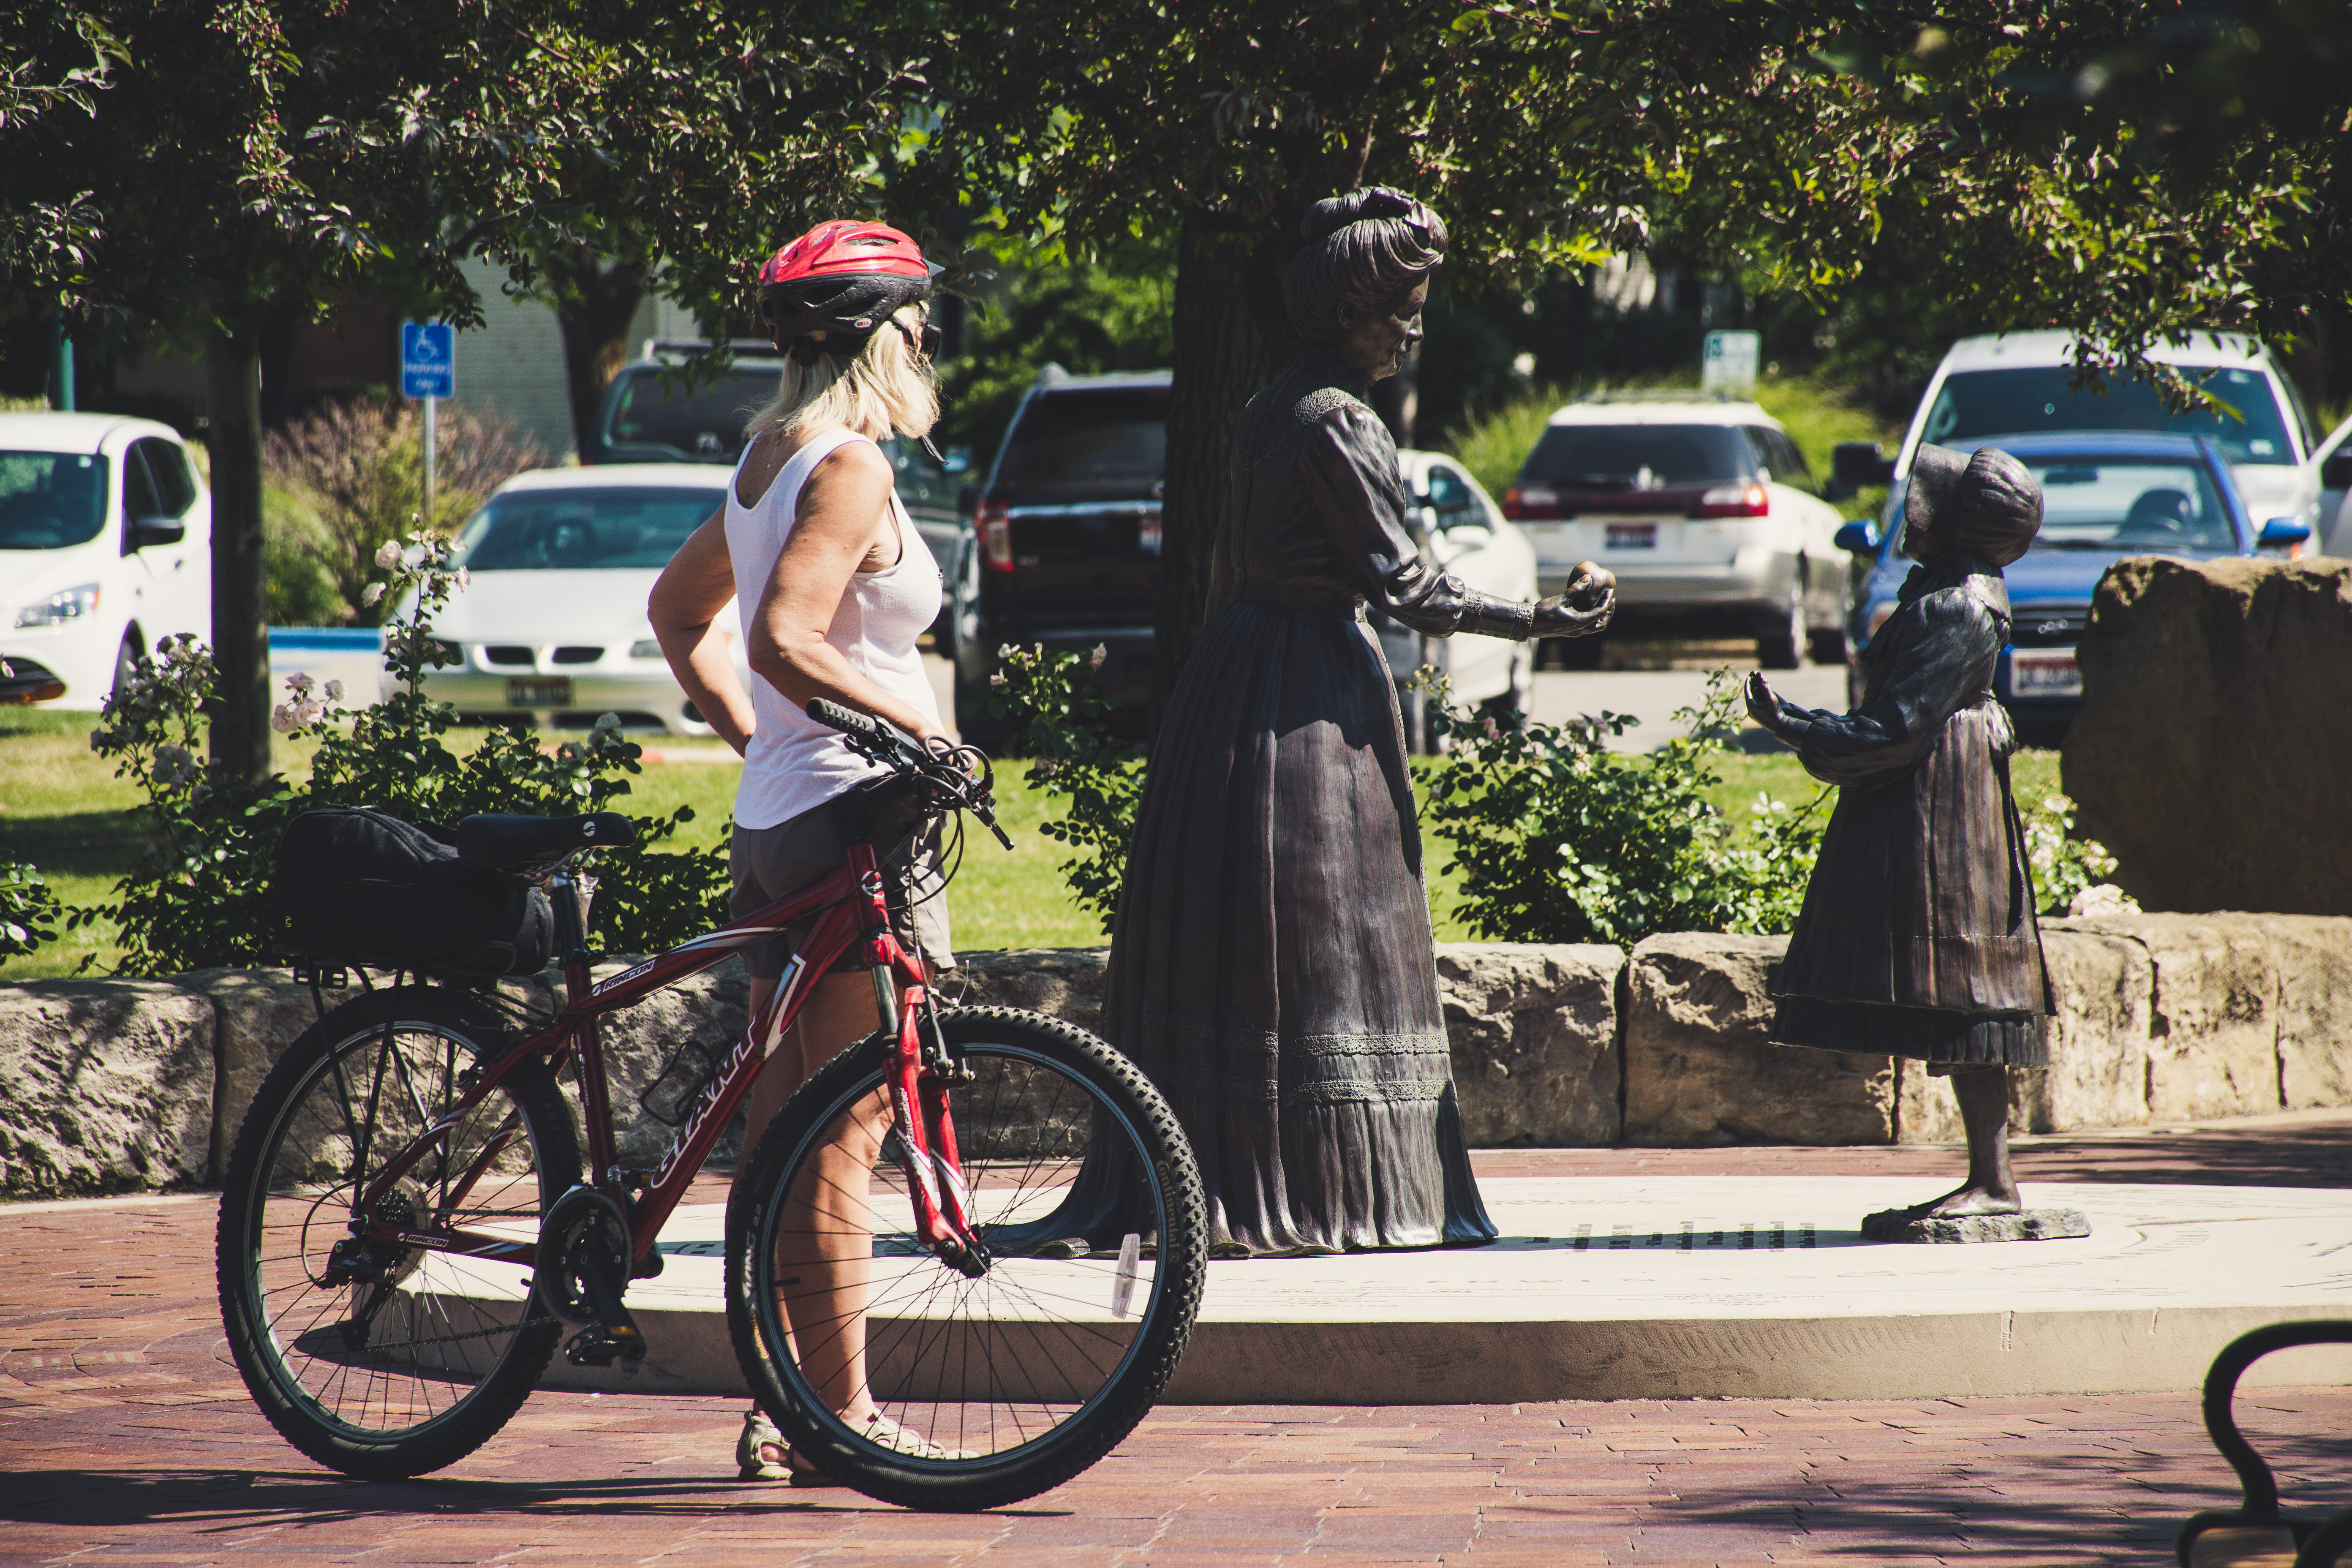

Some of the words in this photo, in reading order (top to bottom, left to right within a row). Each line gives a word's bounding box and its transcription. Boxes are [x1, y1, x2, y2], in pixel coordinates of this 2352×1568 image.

[604, 961, 655, 990] RINCON
[651, 1014, 756, 1188] GIANT
[1157, 1160, 1180, 1248] Continental
[407, 1235, 449, 1247] RINCON
